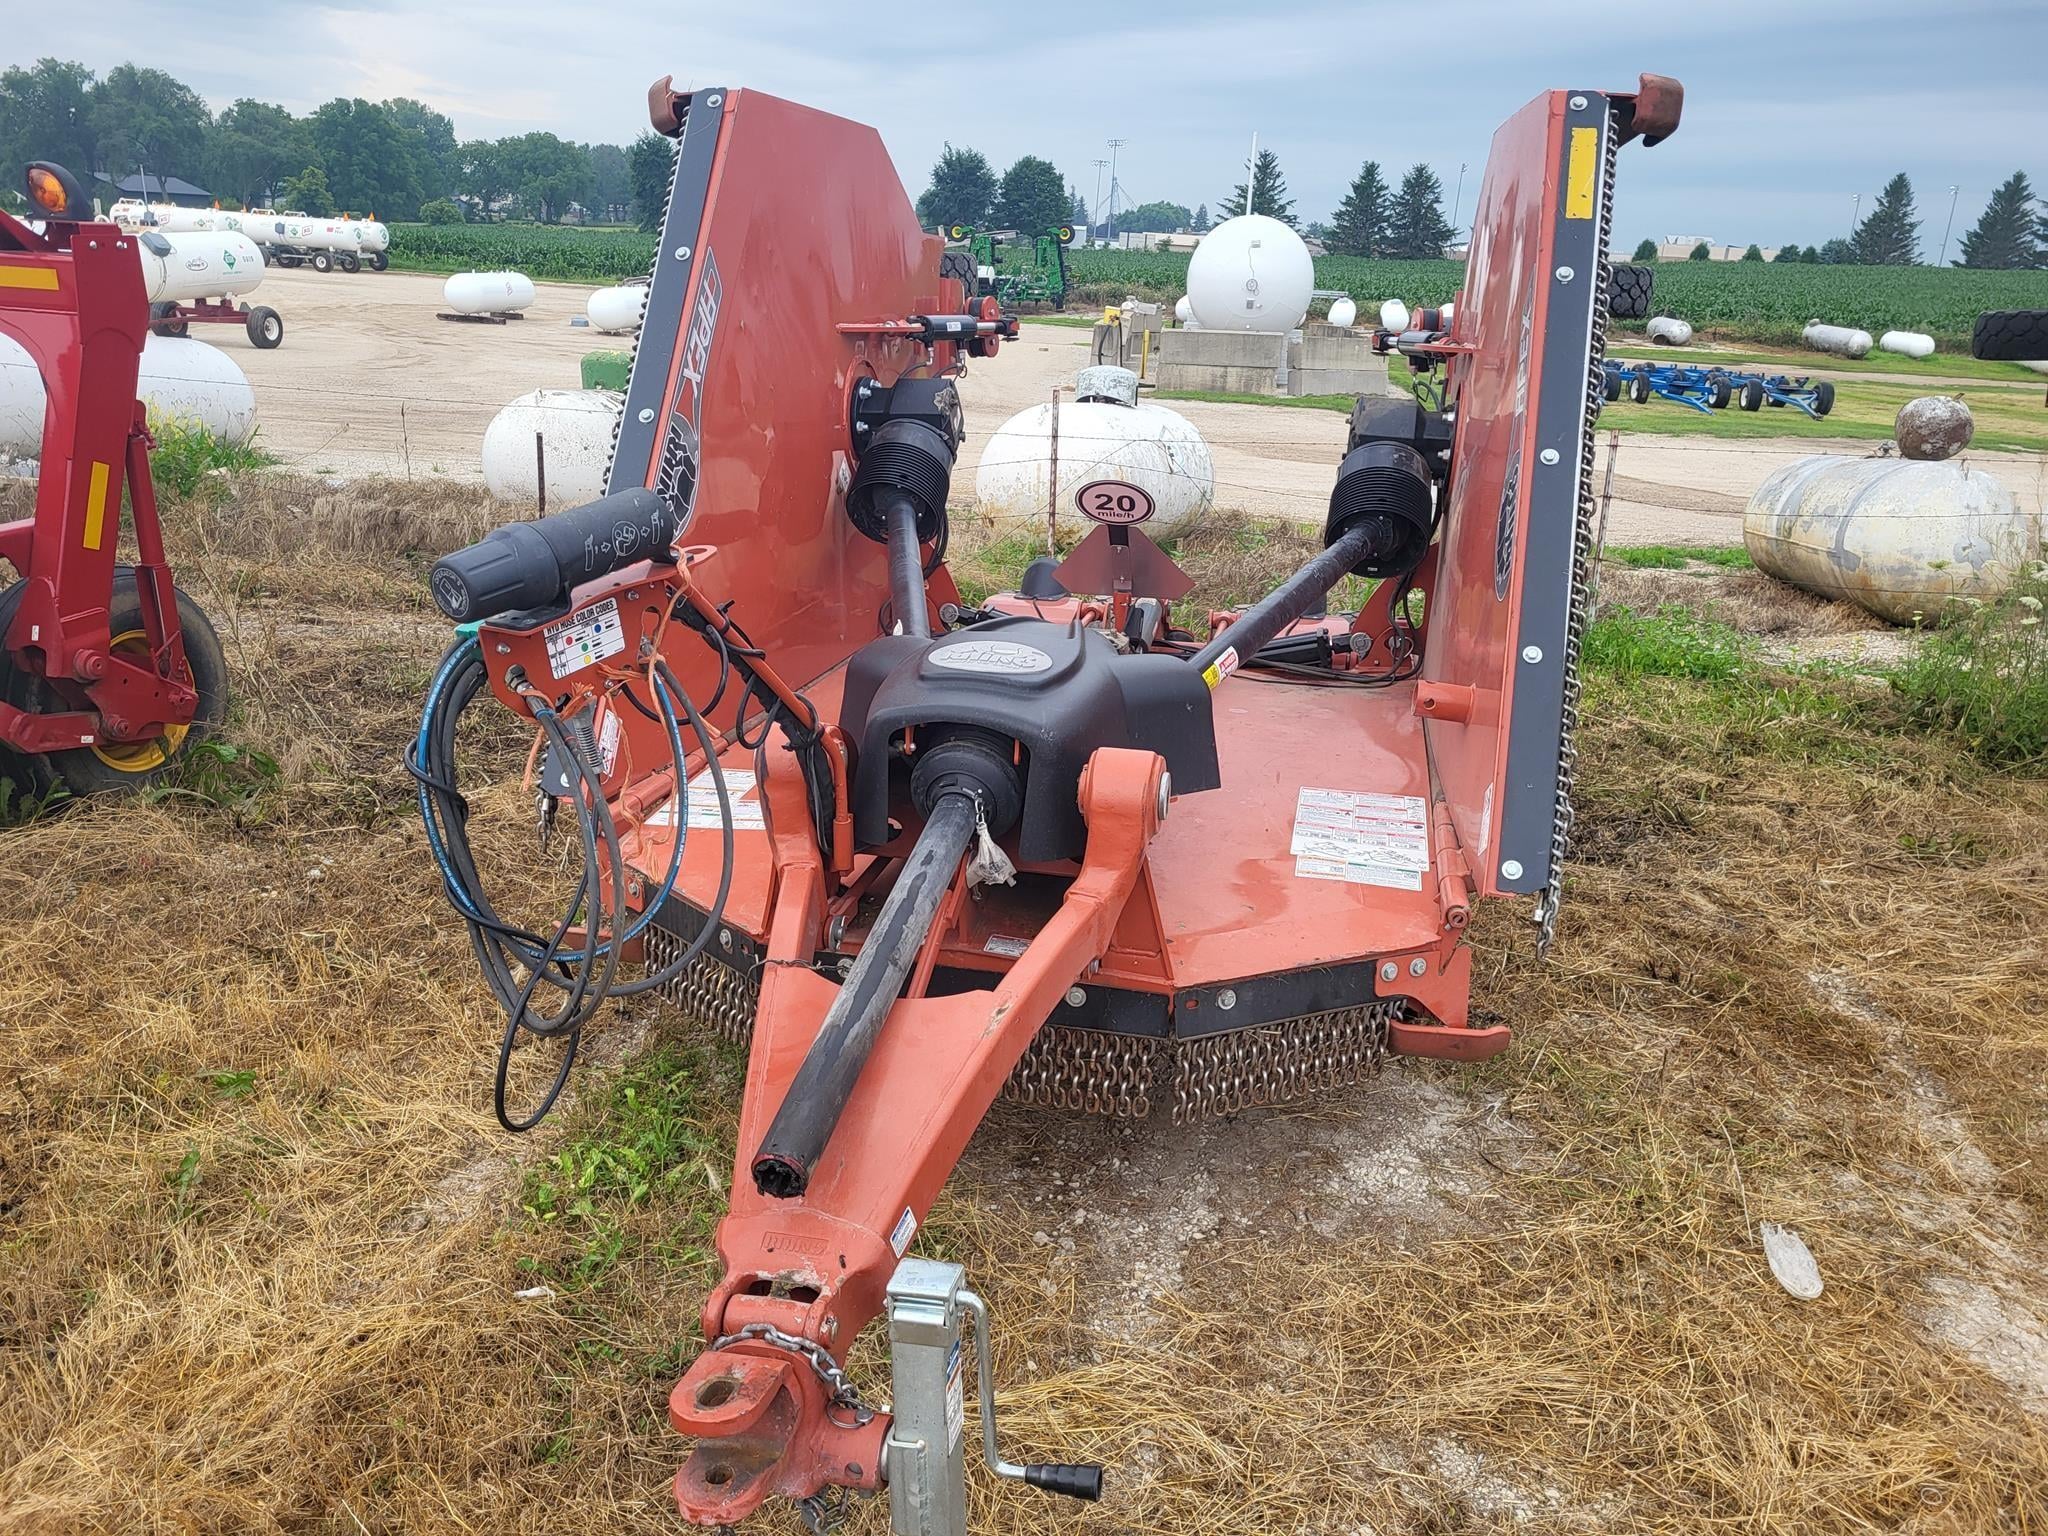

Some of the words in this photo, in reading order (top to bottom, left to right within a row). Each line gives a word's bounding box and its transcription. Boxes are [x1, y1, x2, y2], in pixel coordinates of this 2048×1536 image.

[683, 279, 717, 399] APEX
[655, 421, 688, 505] RHIN
[1094, 493, 1136, 512] 20
[1097, 510, 1135, 519] mile/h
[576, 608, 595, 623] COLOR
[595, 600, 614, 614] CODES
